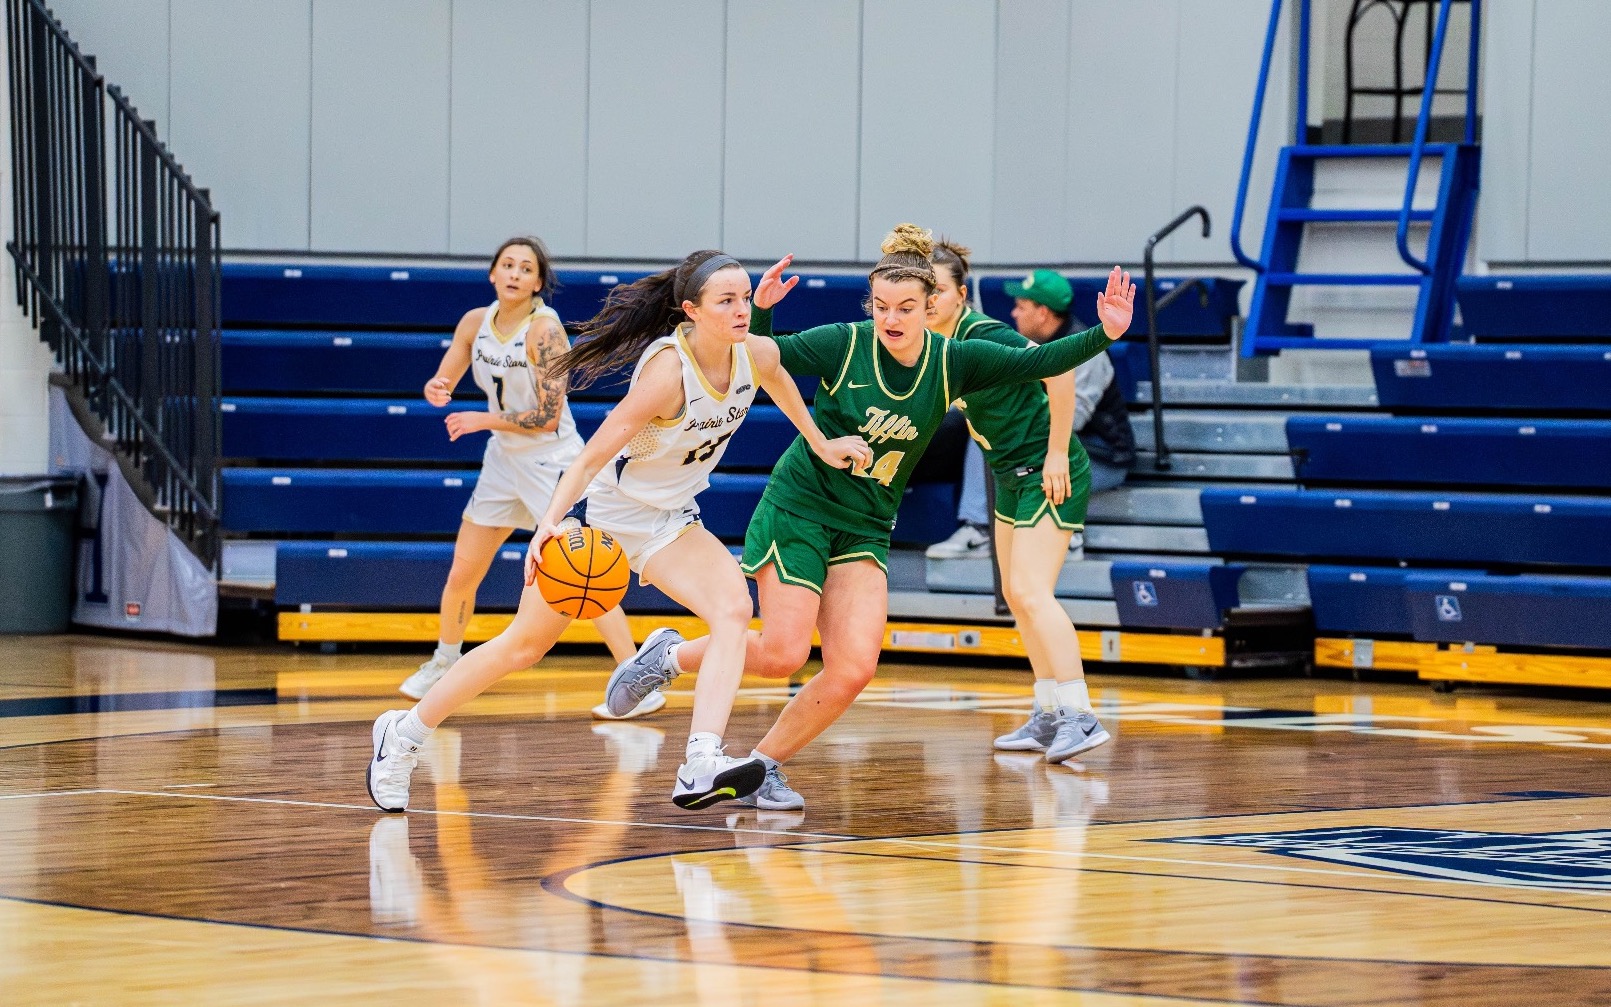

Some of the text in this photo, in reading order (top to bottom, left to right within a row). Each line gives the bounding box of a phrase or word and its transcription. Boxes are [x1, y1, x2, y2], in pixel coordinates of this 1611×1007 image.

[475, 349, 527, 368] Prairie Stars
[491, 374, 505, 412] 7
[857, 405, 919, 445] Tiffin
